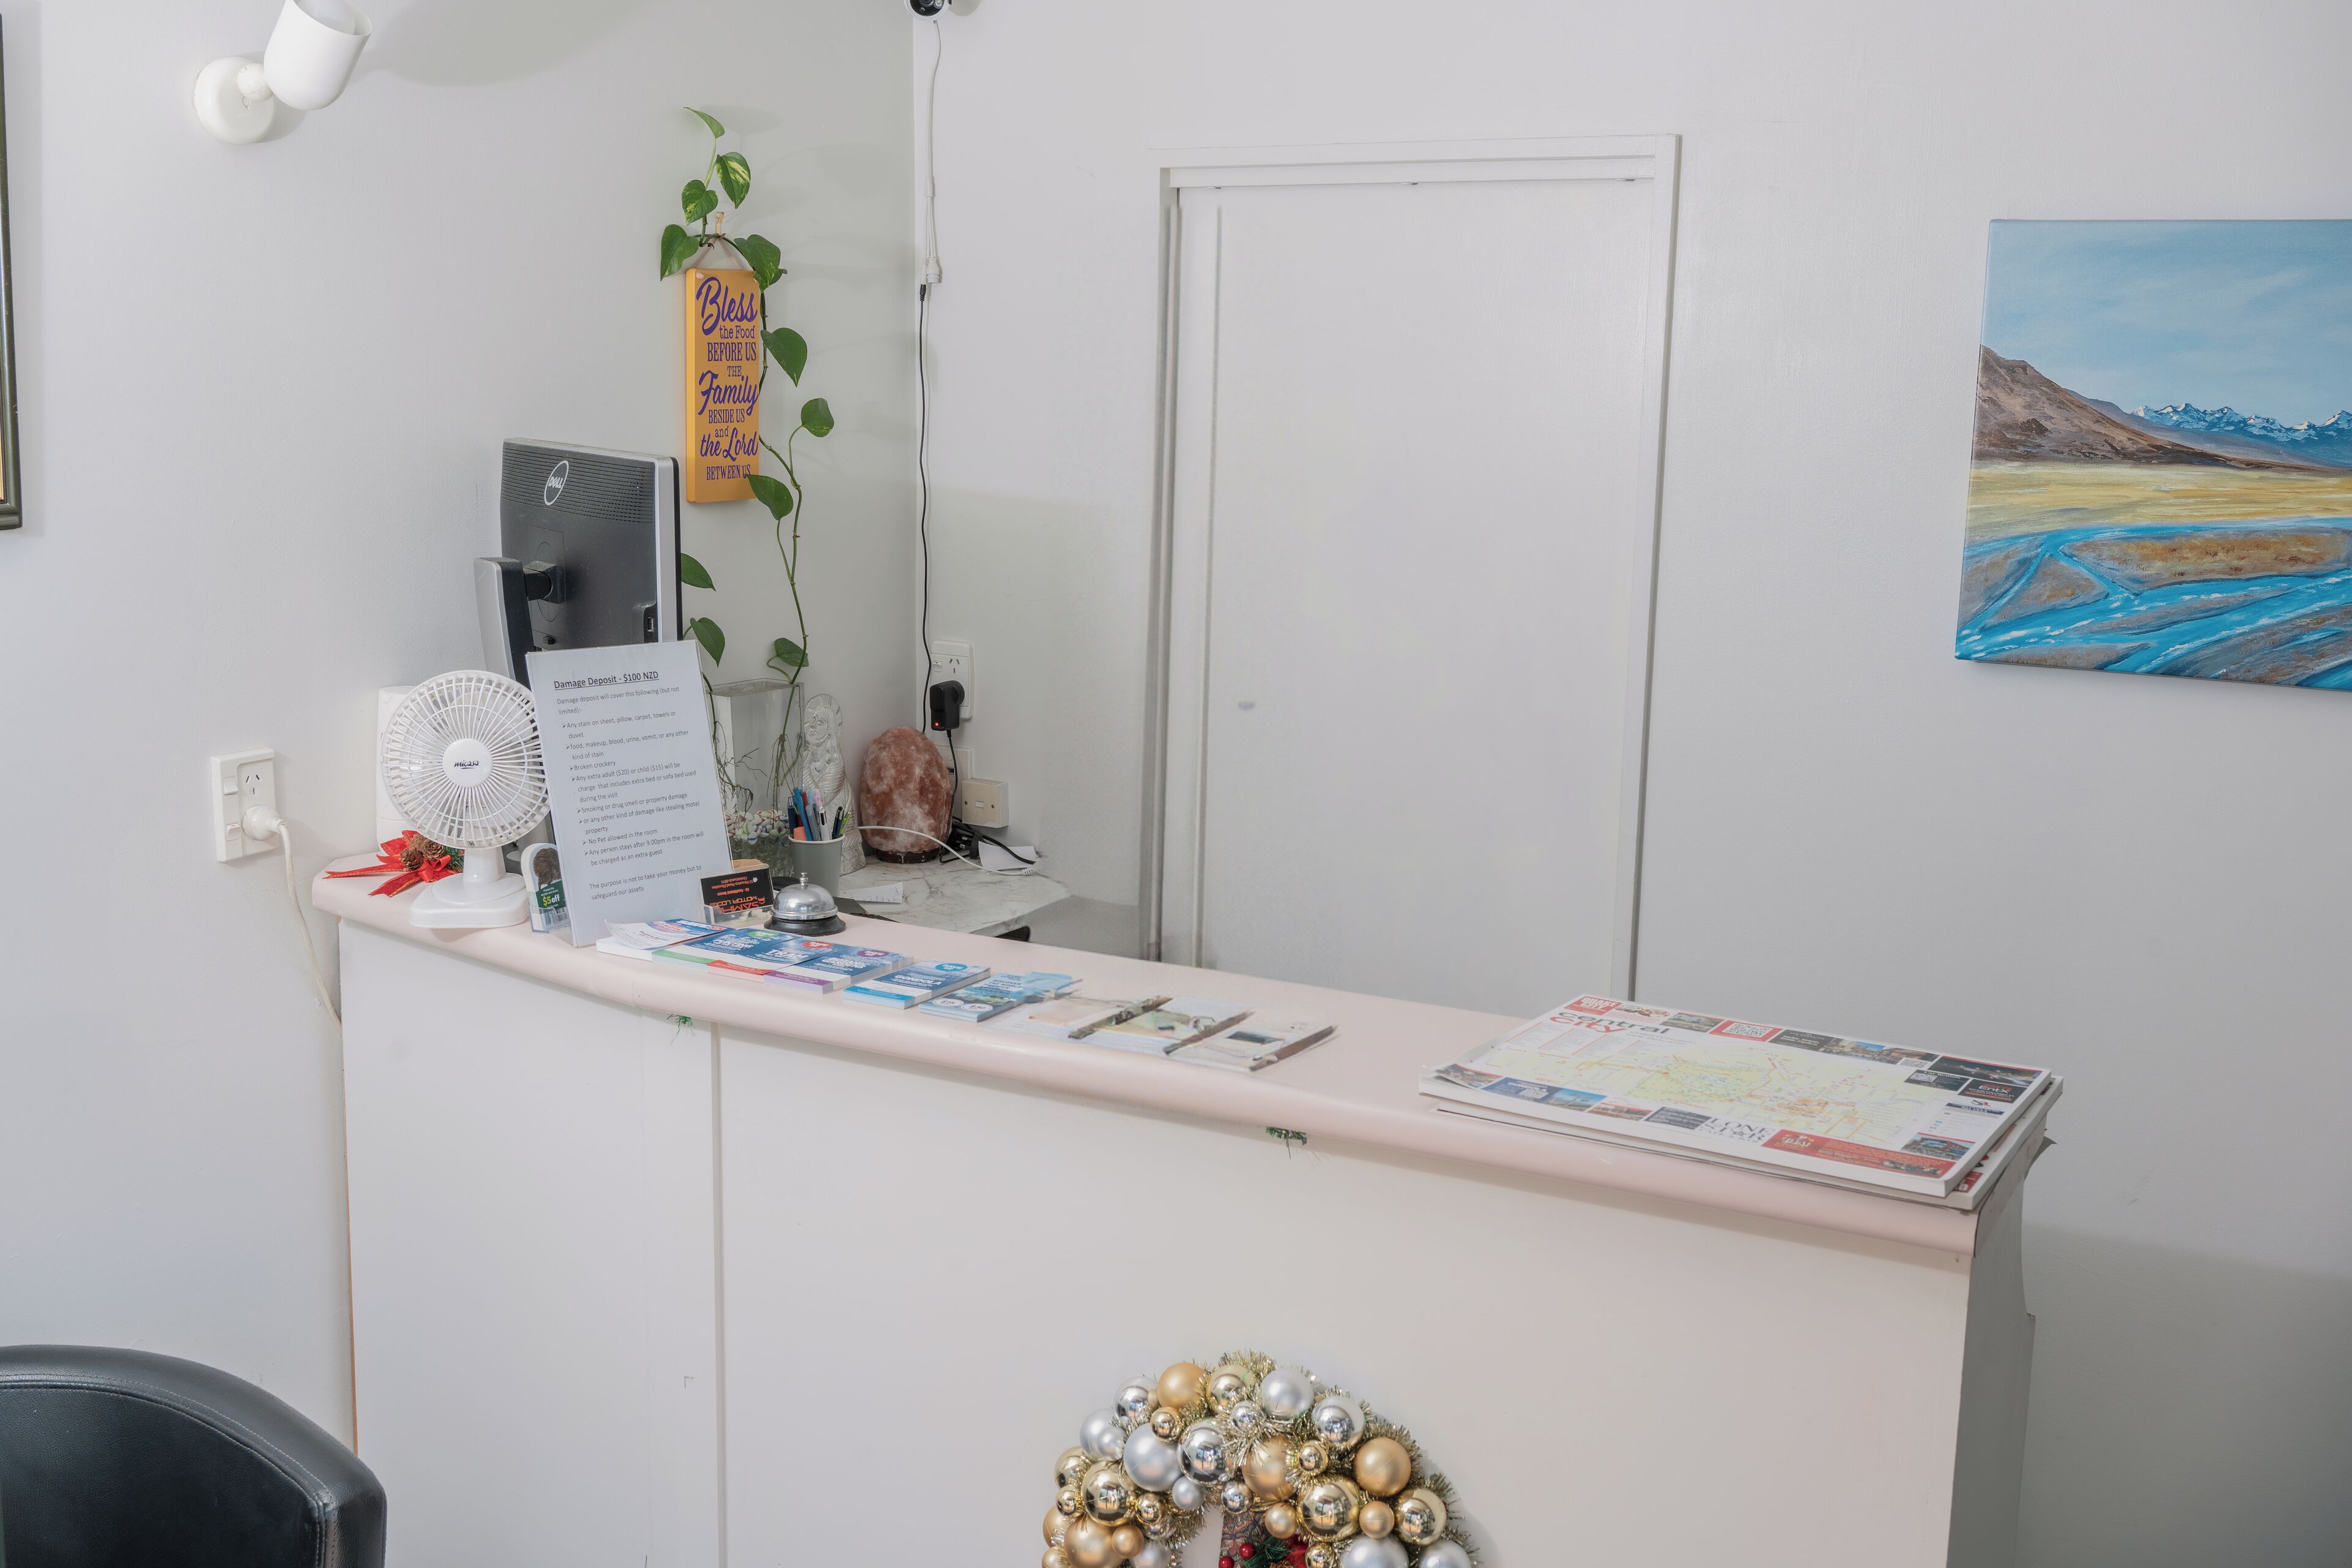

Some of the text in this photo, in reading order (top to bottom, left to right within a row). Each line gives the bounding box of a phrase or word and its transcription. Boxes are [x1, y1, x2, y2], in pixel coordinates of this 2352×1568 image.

[696, 276, 758, 336] Bless
[719, 325, 755, 339] the Food
[707, 342, 756, 362] BEFORE US
[727, 365, 742, 377] THE
[698, 369, 759, 416] Family
[708, 407, 745, 424] BESIDE US
[715, 426, 728, 438] and
[700, 427, 758, 462] the Lord
[706, 464, 751, 481] BETWEEN US
[548, 476, 564, 489] DELL
[554, 680, 586, 689] Damage
[587, 675, 617, 685] Deposit
[623, 673, 641, 683] $100
[643, 671, 658, 680] NZD
[646, 796, 668, 805] property
[586, 827, 608, 835] property
[608, 833, 628, 842] allowed
[599, 856, 620, 865] charged
[649, 849, 663, 858] guest
[601, 880, 622, 889] purpose
[543, 895, 552, 907] $5
[551, 894, 560, 903] off
[592, 890, 617, 900] safeguard
[733, 895, 757, 904] MOTOR
[894, 974, 942, 986] GONDOLA
[1581, 997, 1618, 1007] QUAKE
[1711, 1118, 1776, 1135] LONE
